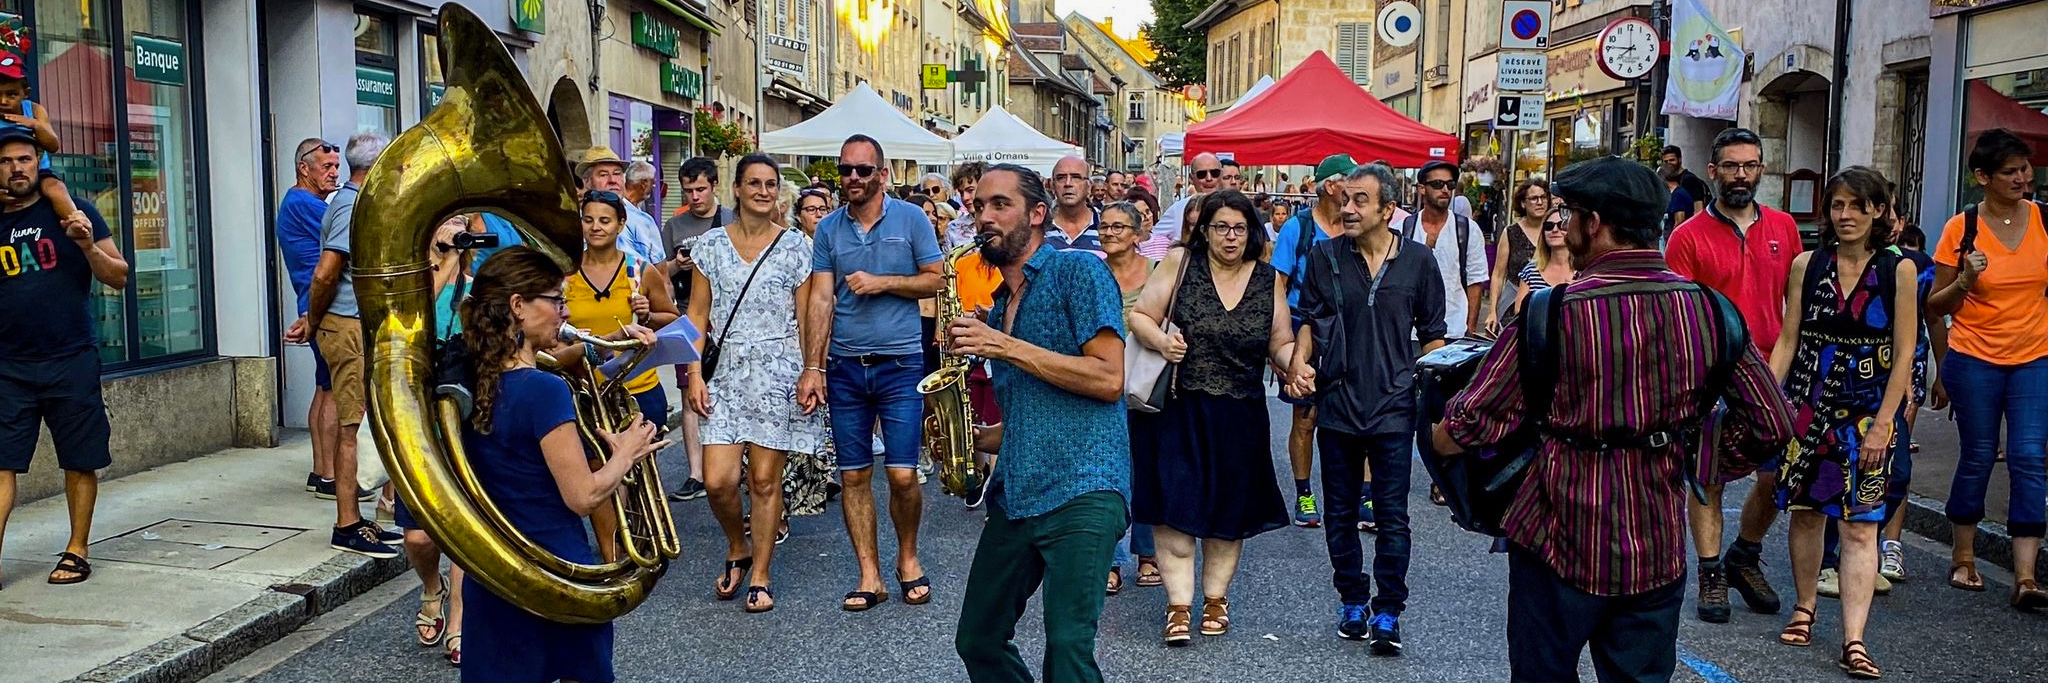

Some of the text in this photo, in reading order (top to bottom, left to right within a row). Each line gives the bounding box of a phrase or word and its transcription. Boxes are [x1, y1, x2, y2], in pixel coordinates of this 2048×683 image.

[770, 36, 806, 51] VENDU
[136, 45, 179, 74] Banque
[1505, 57, 1540, 65] RÉSERVÉ
[357, 78, 393, 95] ssurances
[963, 151, 1029, 161] Ville d'Ornans
[135, 217, 166, 228] OFFERTS
[10, 227, 43, 244] funny
[0, 238, 57, 276] DAD
